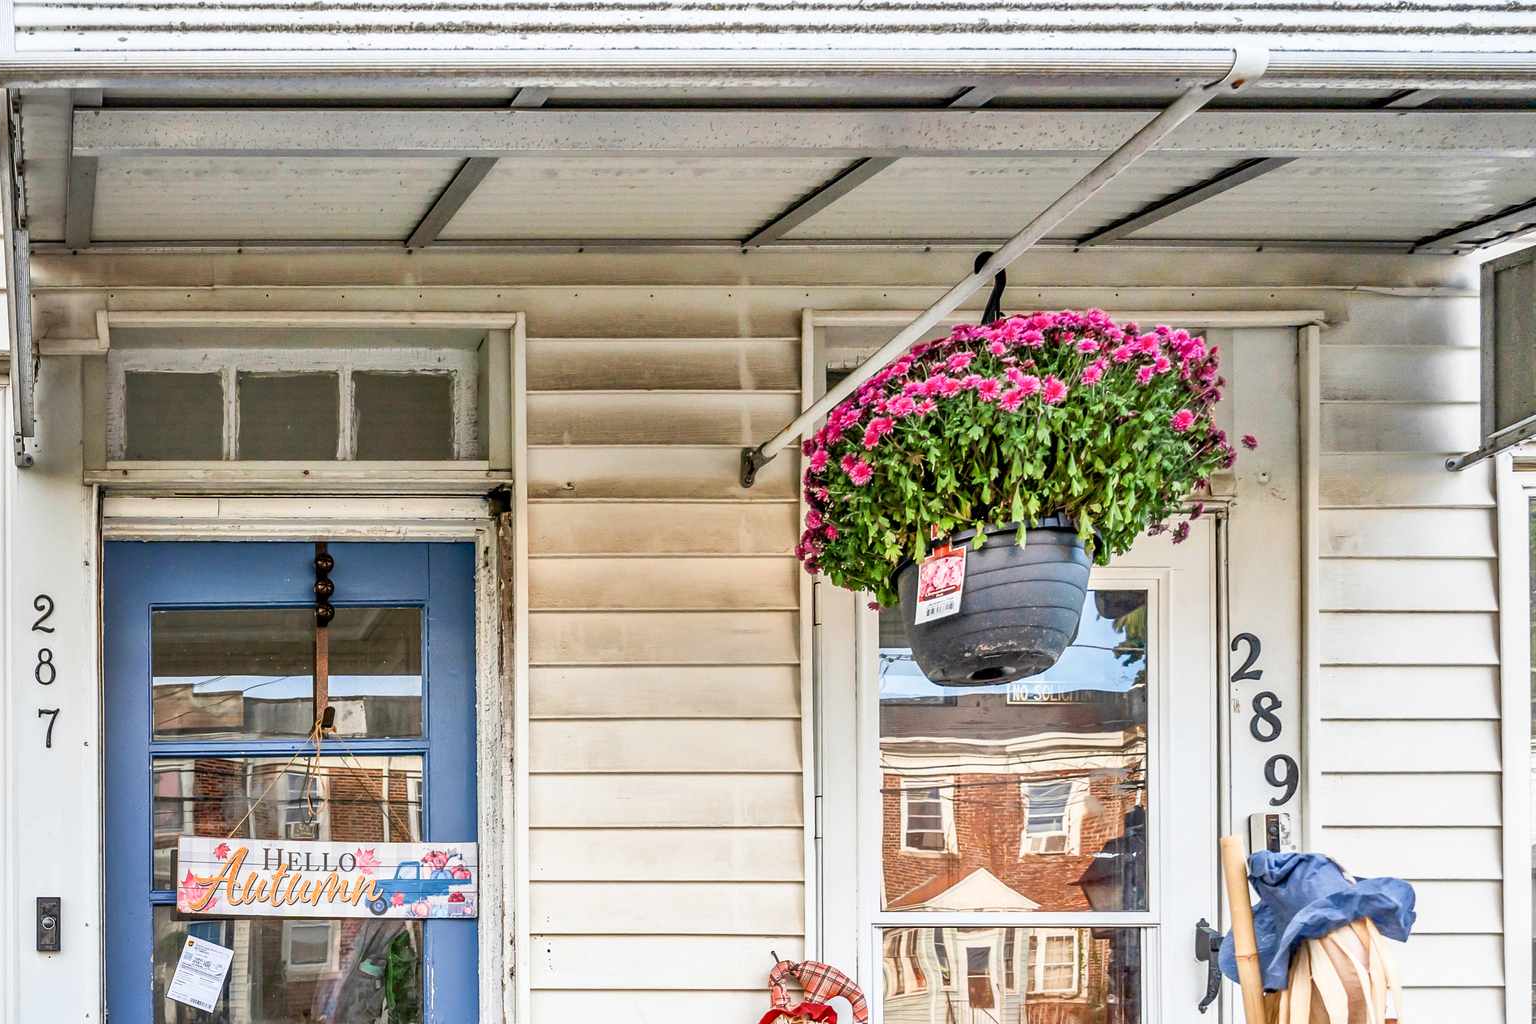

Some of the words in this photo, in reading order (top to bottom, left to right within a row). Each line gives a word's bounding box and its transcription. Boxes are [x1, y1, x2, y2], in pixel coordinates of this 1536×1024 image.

[31, 593, 61, 749] 287
[1012, 684, 1028, 701] NO
[1230, 632, 1299, 806] 289
[188, 846, 385, 911] Autumn
[262, 847, 357, 873] HELLO
